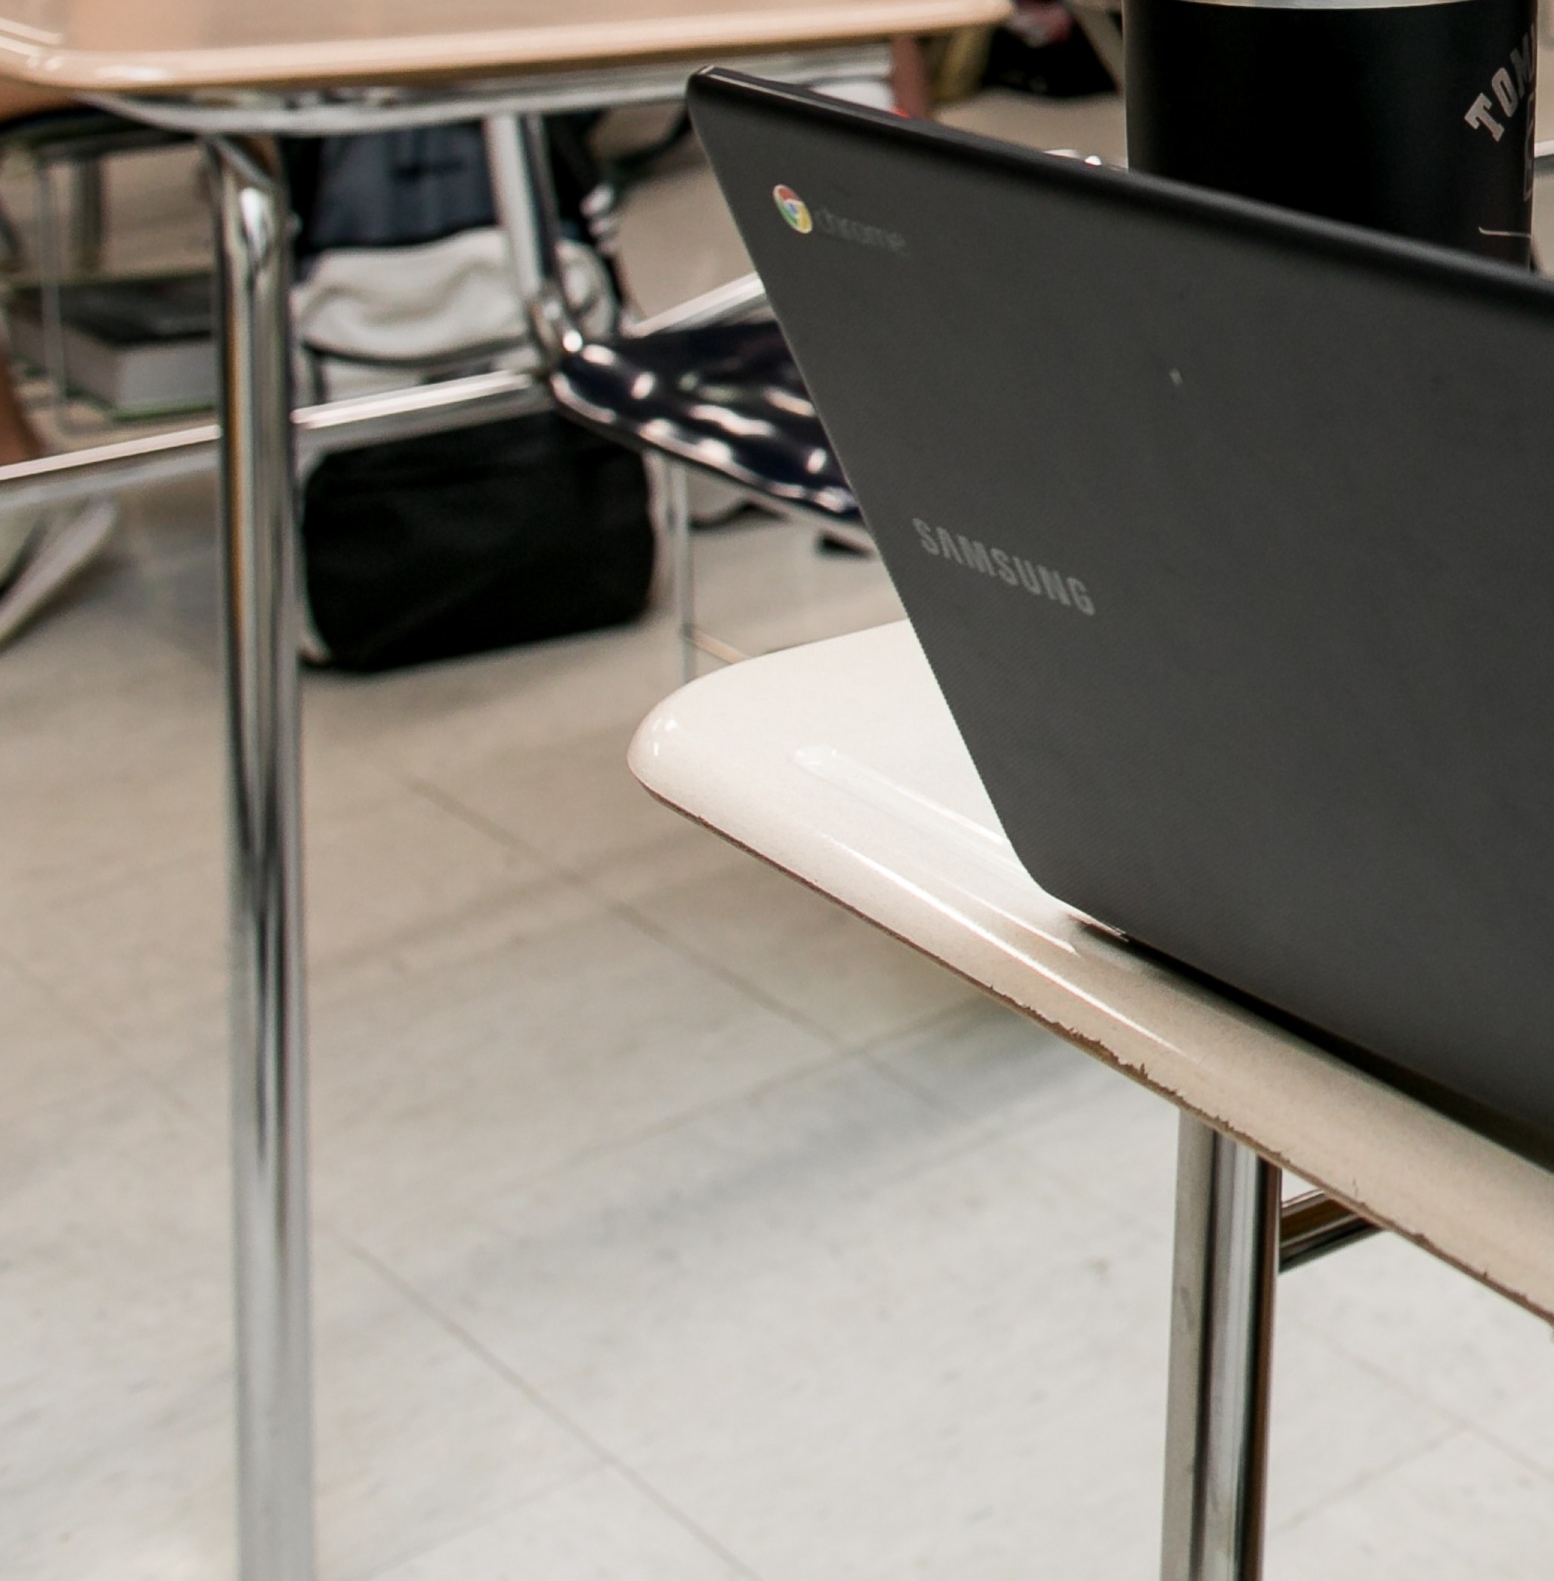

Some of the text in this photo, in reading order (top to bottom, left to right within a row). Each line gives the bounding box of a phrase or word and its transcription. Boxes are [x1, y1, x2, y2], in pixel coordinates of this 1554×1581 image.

[1464, 24, 1537, 143] TOM
[813, 206, 906, 253] chrome
[912, 517, 1097, 617] SAMSUNG
